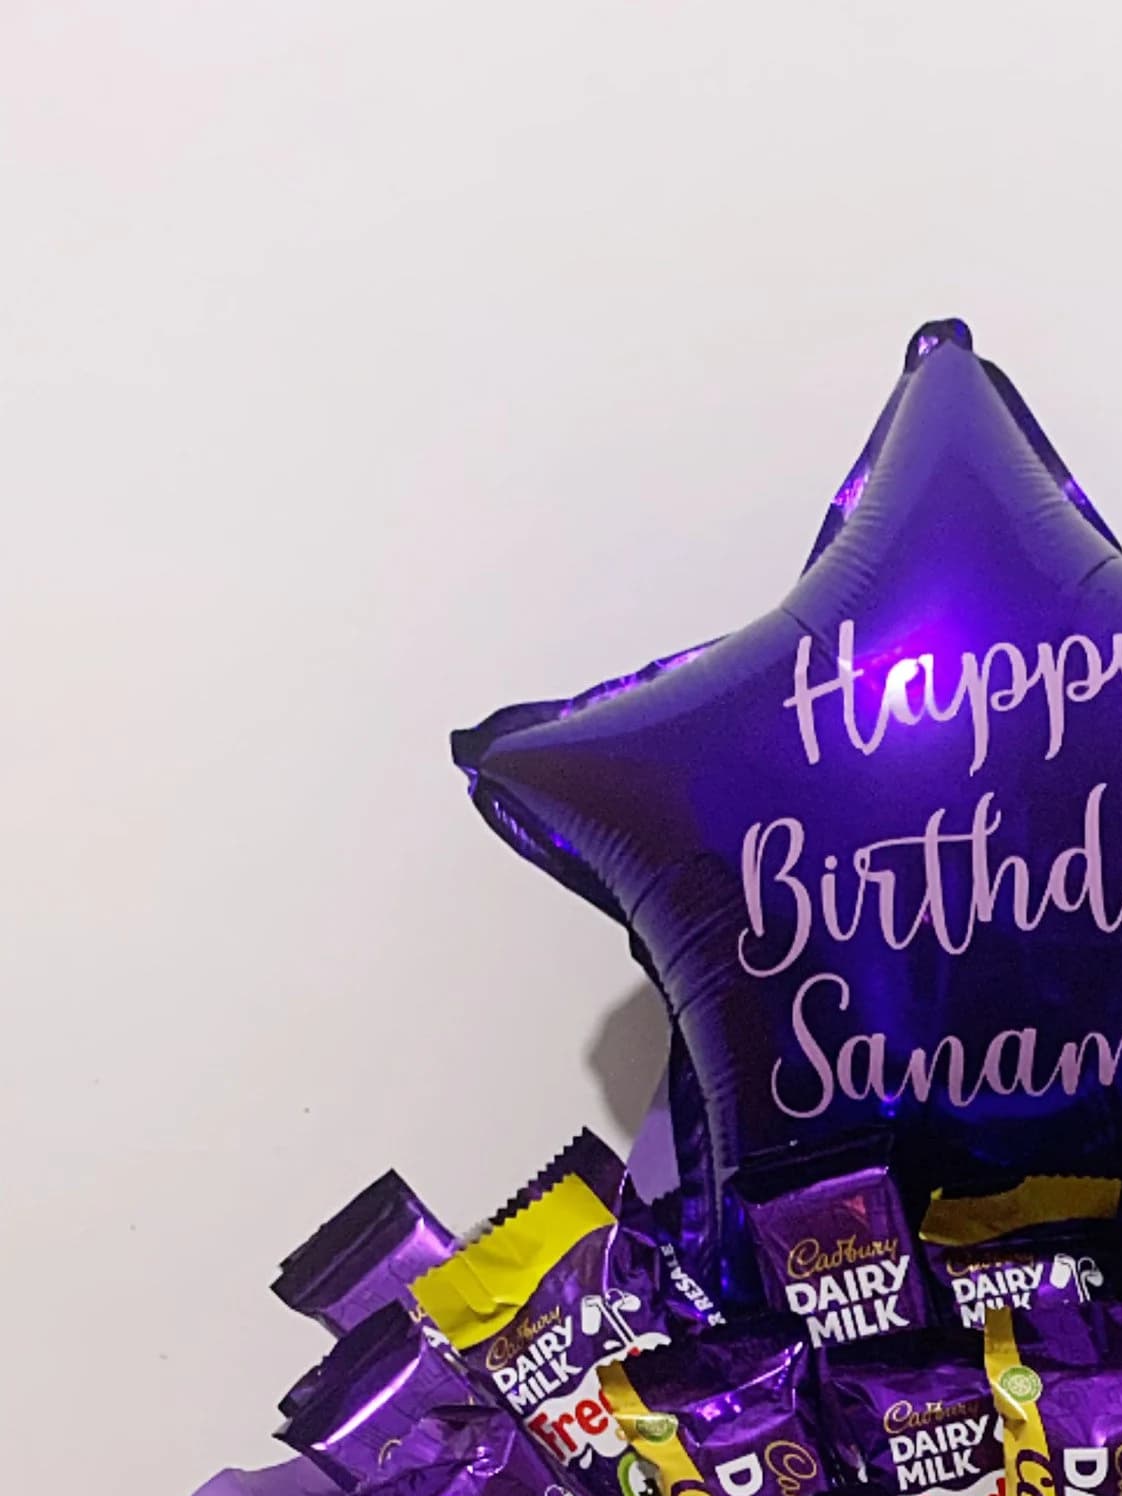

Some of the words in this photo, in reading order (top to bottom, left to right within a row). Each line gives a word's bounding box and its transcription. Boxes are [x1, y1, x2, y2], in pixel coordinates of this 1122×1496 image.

[787, 1233, 898, 1279] Cadbury
[785, 1255, 910, 1315] DAIRY
[952, 1263, 1043, 1304] DAIRY
[486, 1305, 564, 1372] Cadbury
[806, 1294, 910, 1348] MILK
[492, 1316, 574, 1394] DAIRY
[508, 1351, 583, 1415] MILK
[883, 1400, 982, 1435] Cadbury
[889, 1413, 990, 1465] DAIRY
[897, 1447, 980, 1492] MILK
